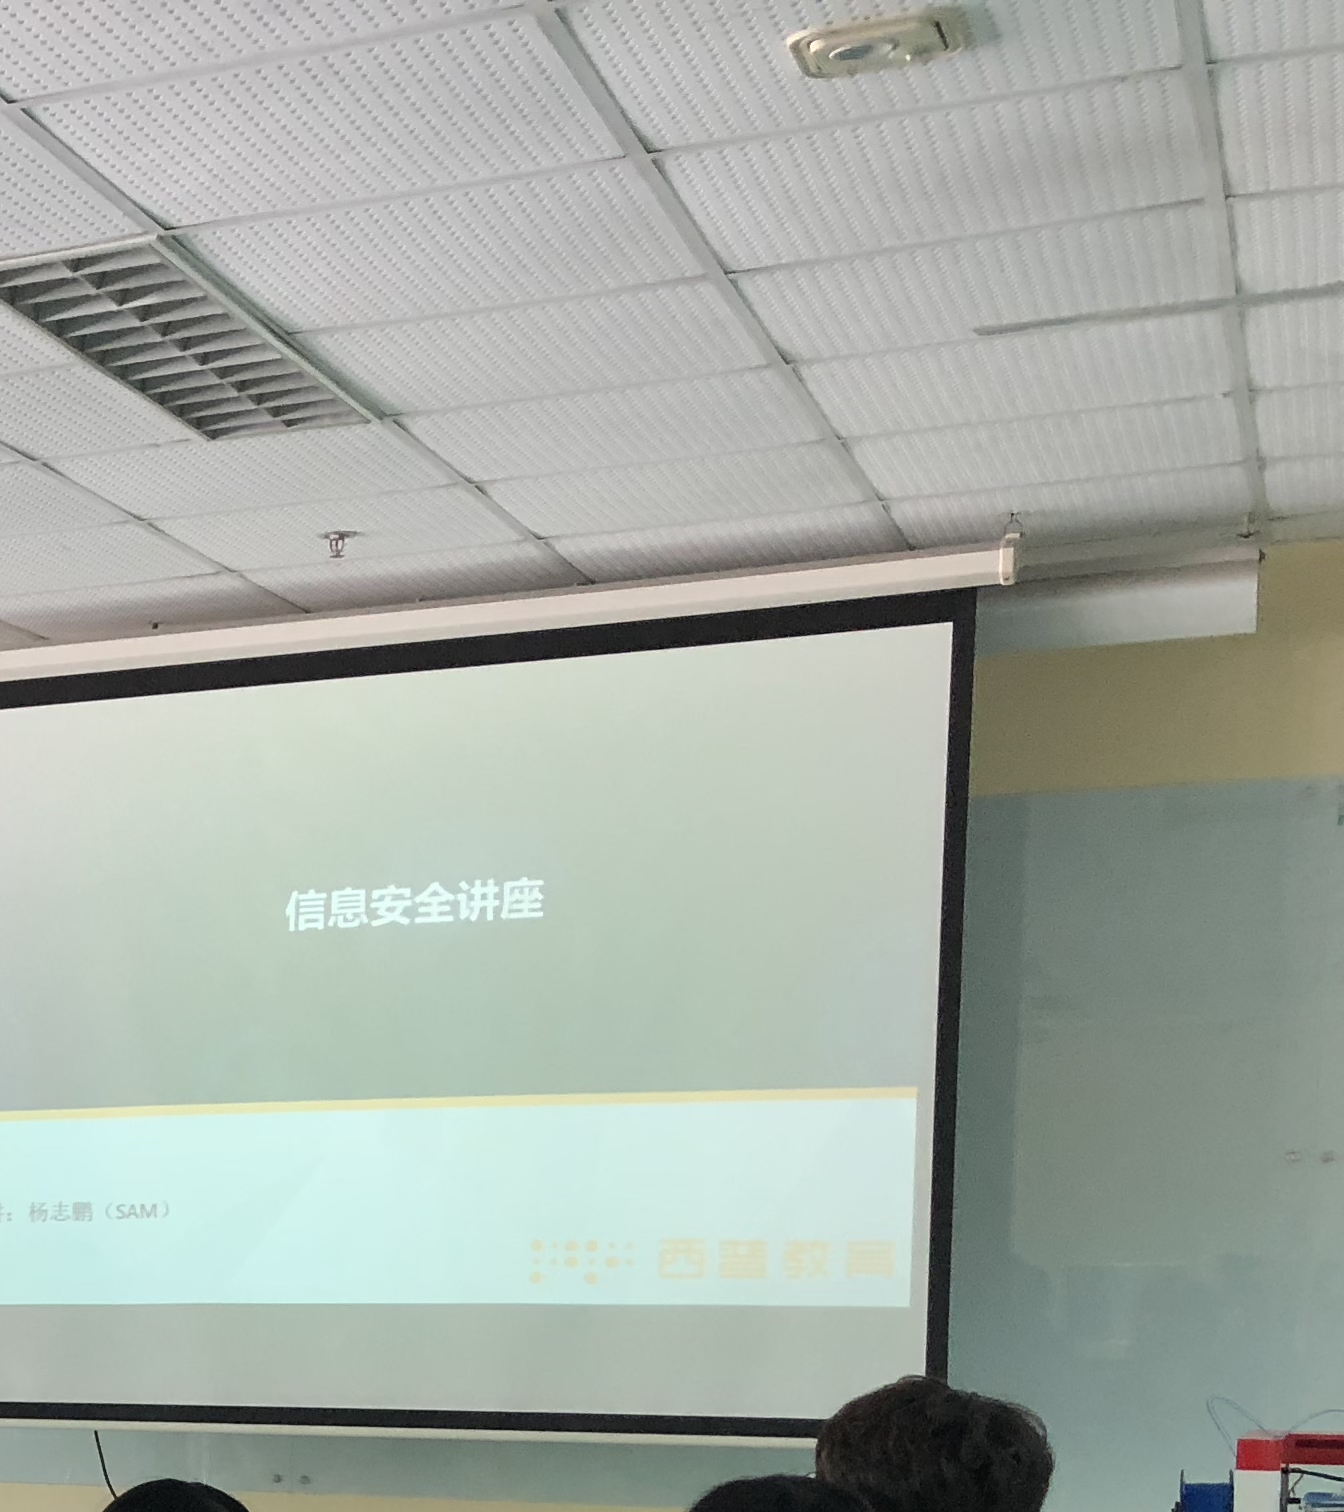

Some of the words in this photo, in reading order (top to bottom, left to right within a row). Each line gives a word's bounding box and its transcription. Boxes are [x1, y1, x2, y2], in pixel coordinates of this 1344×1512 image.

[285, 877, 545, 932] 信息安全讲座
